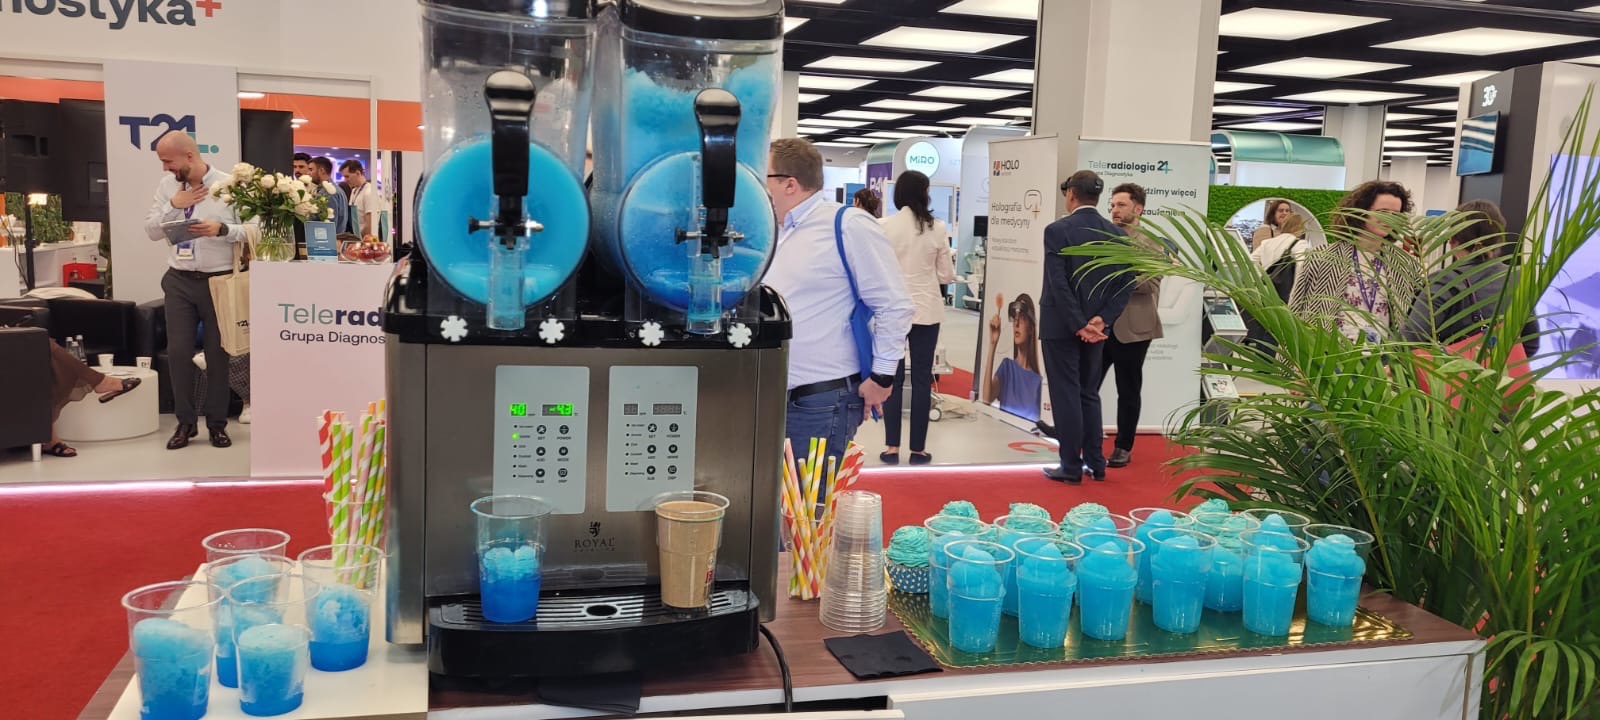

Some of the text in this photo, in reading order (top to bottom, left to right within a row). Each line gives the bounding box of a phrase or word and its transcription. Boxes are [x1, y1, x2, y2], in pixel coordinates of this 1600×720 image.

[1000, 160, 1019, 170] HOLO
[1088, 160, 1156, 173] Teleradiologia
[1171, 189, 1197, 199] więcej
[992, 201, 1022, 214] Holografia
[1000, 218, 1031, 229] medycyny
[280, 330, 324, 344] Grupa
[575, 538, 614, 549] ROYAL
